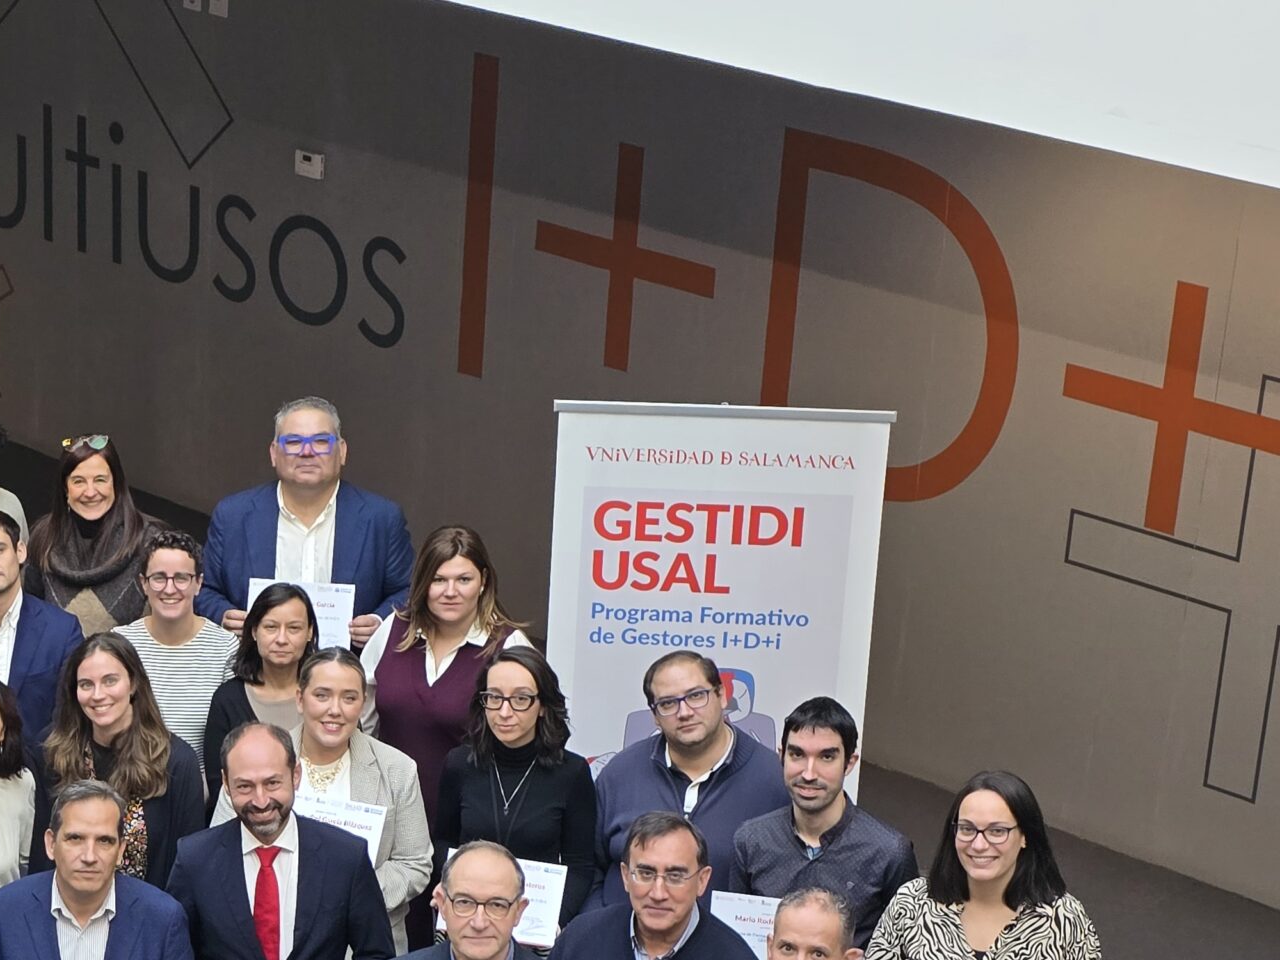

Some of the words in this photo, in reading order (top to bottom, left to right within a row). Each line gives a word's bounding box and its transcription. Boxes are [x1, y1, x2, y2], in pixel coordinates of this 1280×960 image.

[738, 451, 856, 470] SALAMANCA
[593, 500, 805, 548] GESTIDI
[591, 549, 730, 595] USAL
[590, 602, 693, 625] Programa
[700, 606, 809, 628] Formativo
[588, 627, 615, 645] de
[621, 628, 716, 648] Gestores
[722, 631, 781, 650] I+D+i
